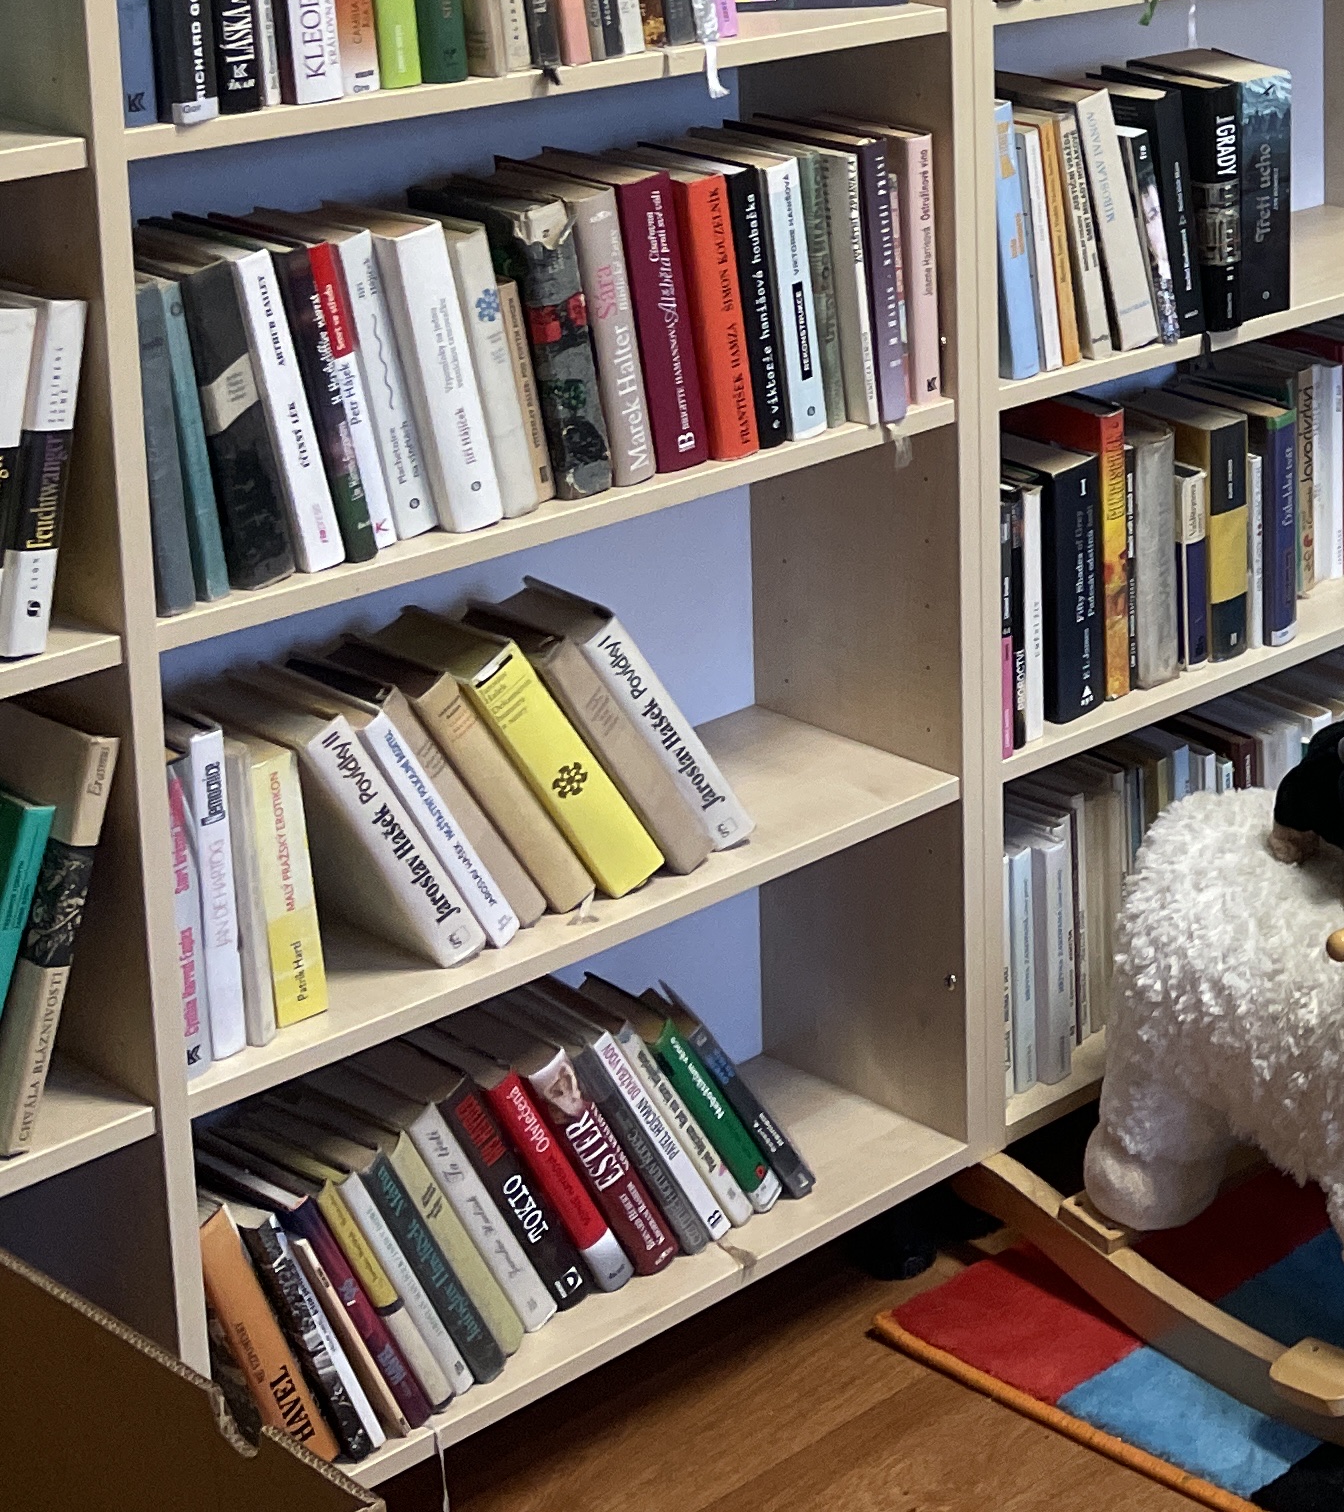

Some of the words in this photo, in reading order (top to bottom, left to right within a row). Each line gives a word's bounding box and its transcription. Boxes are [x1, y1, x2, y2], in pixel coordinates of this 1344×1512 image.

[614, 326, 636, 396] Halter
[622, 398, 649, 470] Marek
[333, 739, 378, 805] Povídky
[372, 803, 413, 862] Hašek
[405, 852, 463, 925] Jaroslav
[509, 1087, 549, 1153] Odvlečená
[566, 1111, 626, 1190] ESTER
[504, 1175, 550, 1244] TOKIO
[270, 1366, 315, 1442] HAVEL
